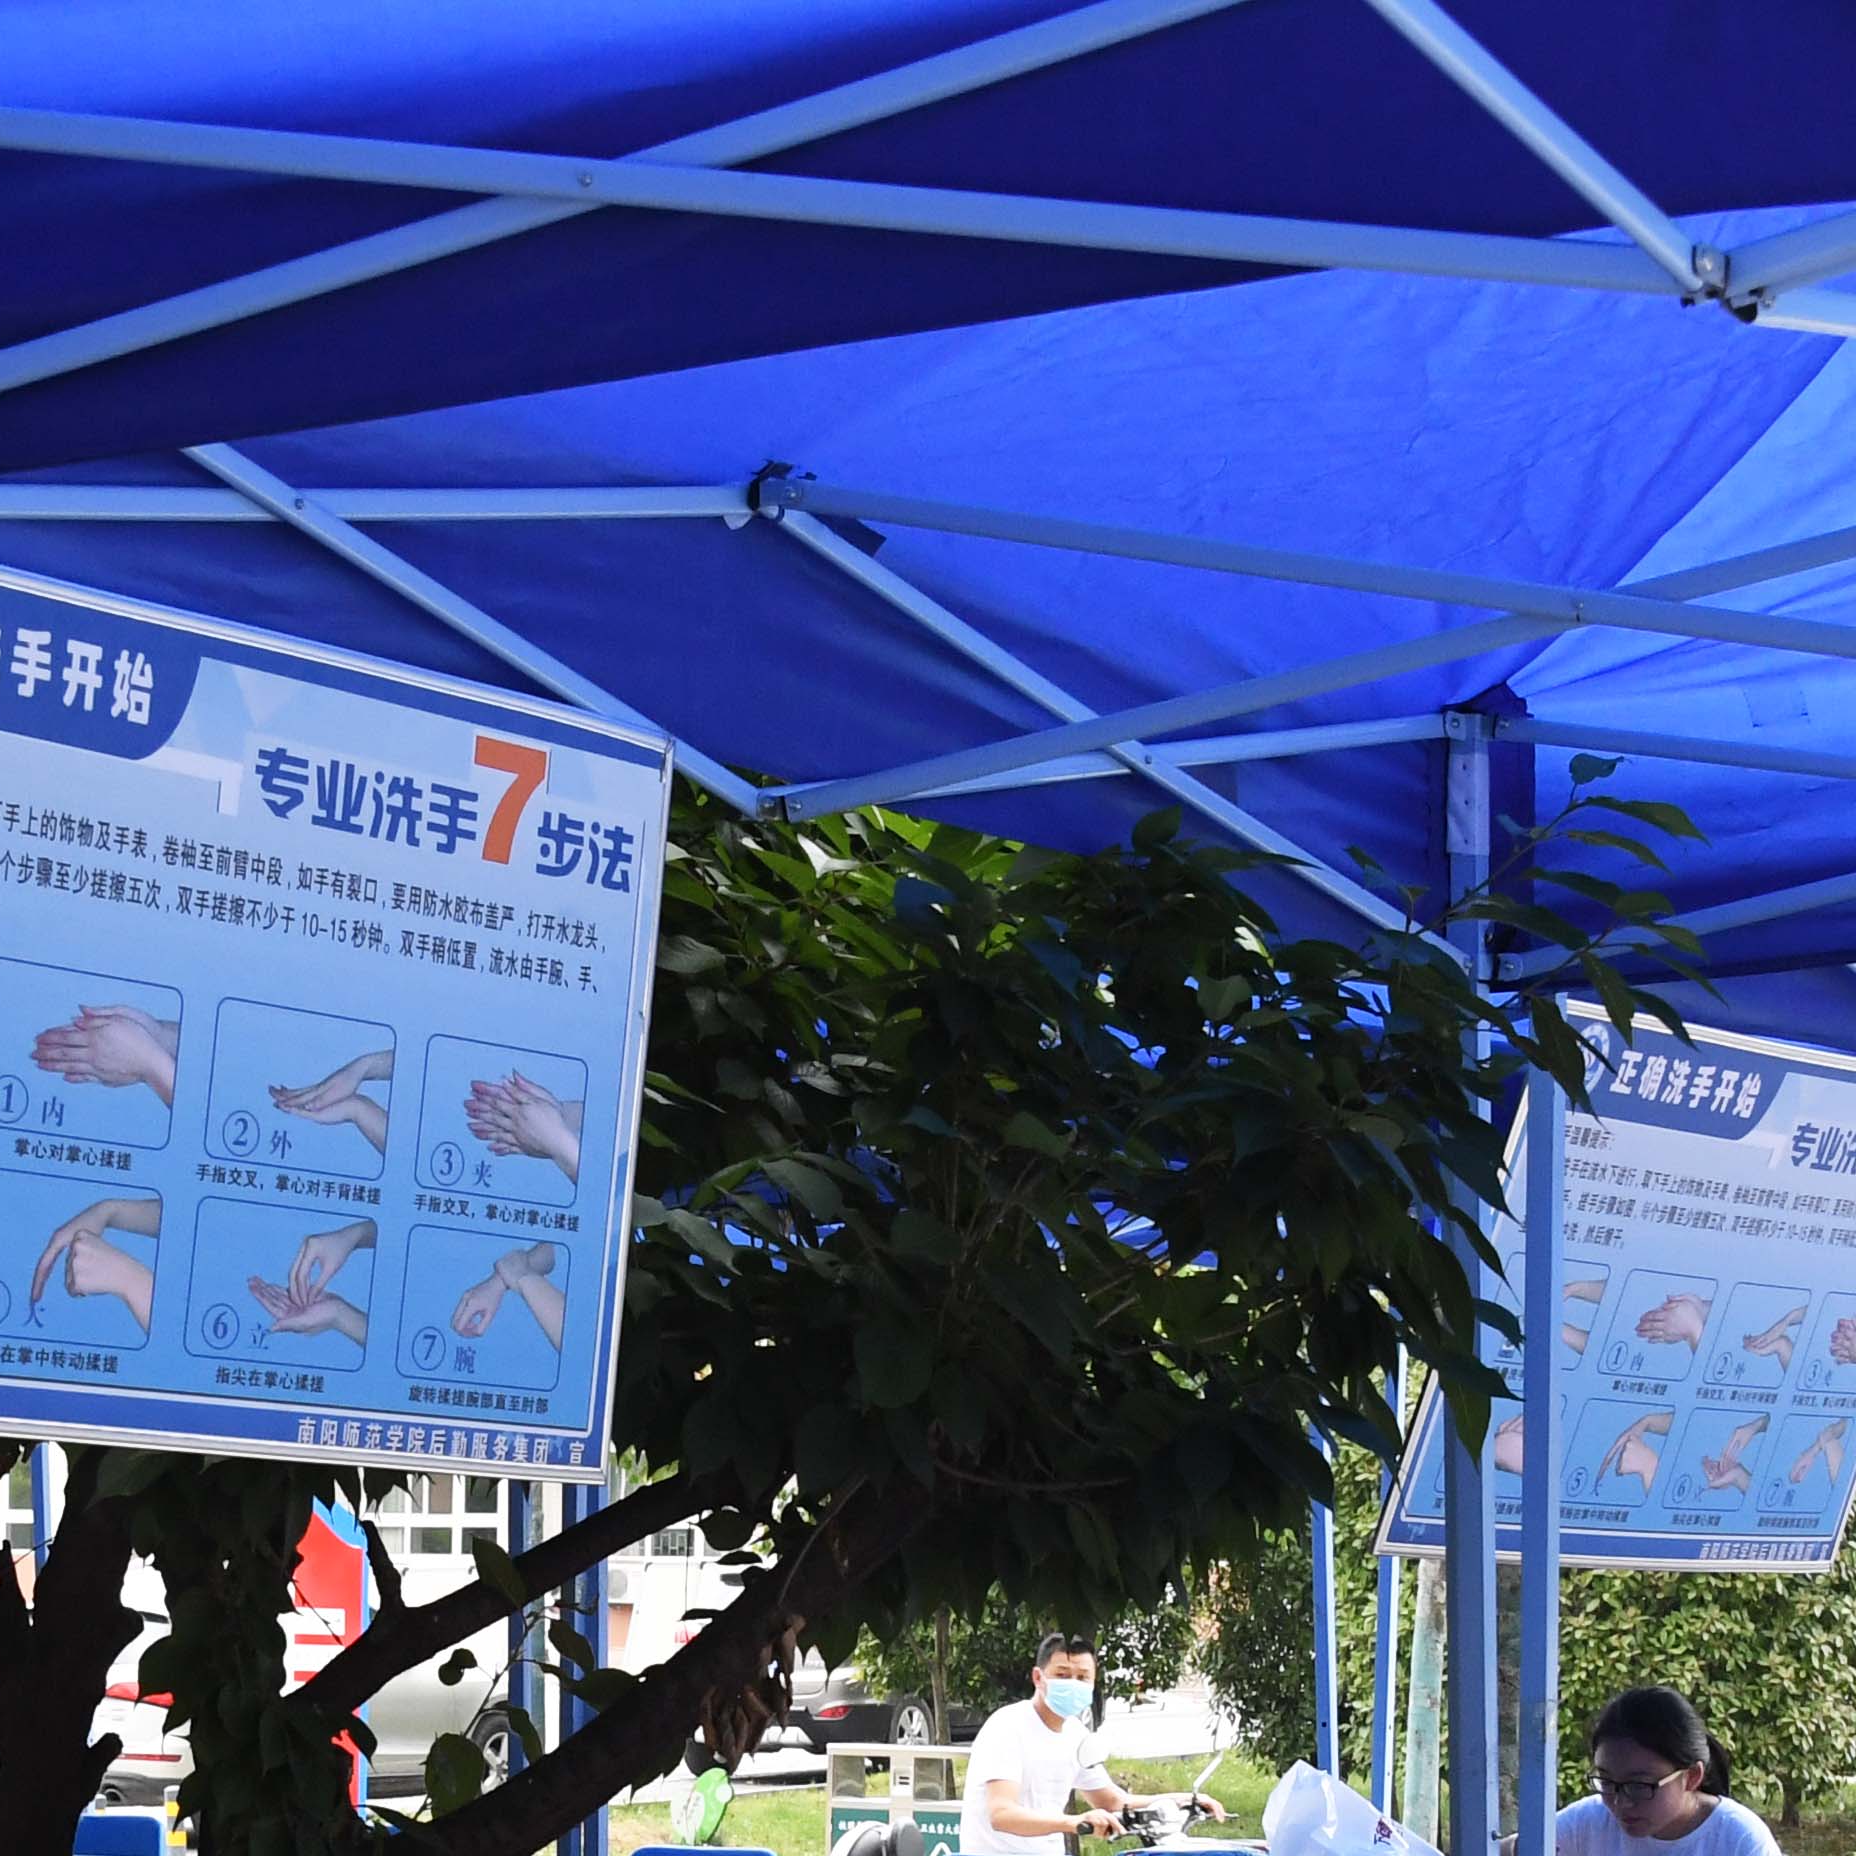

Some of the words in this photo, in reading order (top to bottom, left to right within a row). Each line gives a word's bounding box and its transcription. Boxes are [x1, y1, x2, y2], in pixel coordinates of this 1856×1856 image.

[1609, 1049, 1763, 1120] 正确洗手开始
[14, 1137, 133, 1172] 掌心对掌心揉搓
[215, 1365, 325, 1394] 指尖在掌心揉搓
